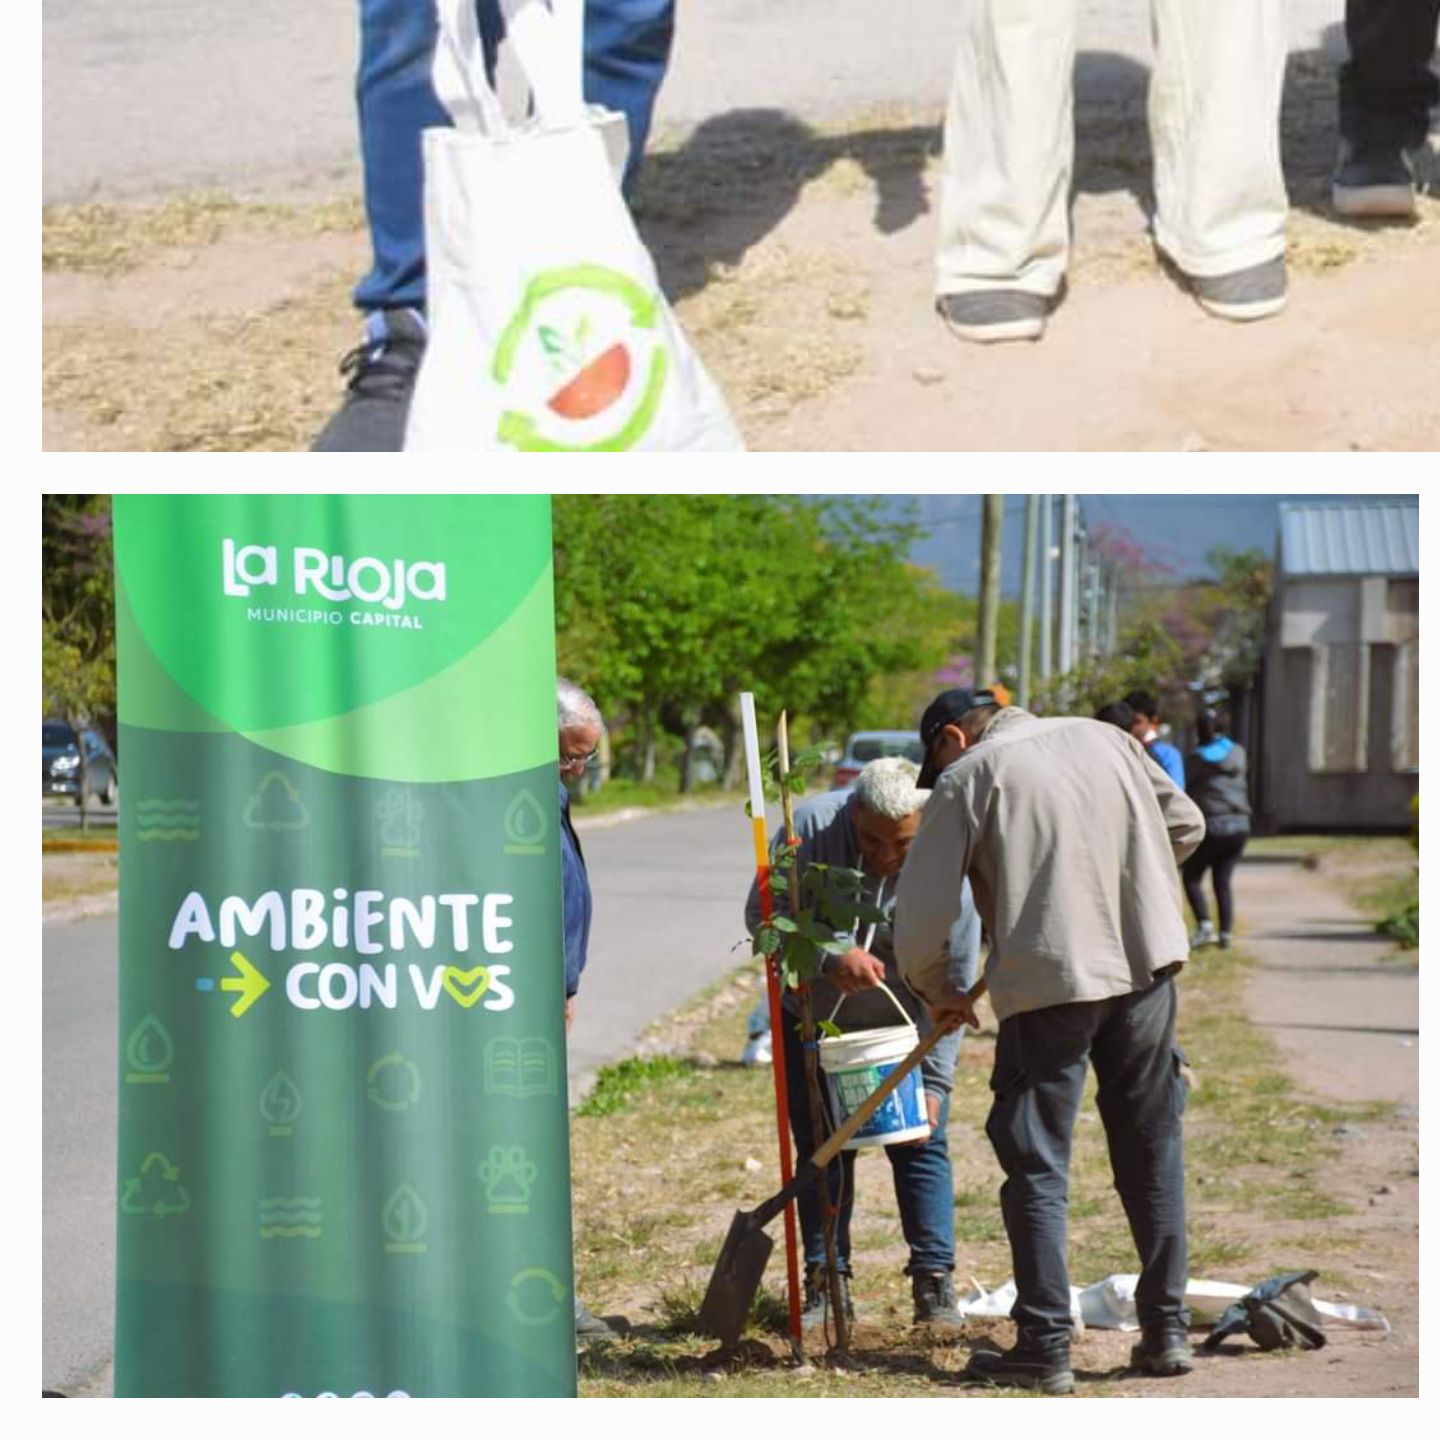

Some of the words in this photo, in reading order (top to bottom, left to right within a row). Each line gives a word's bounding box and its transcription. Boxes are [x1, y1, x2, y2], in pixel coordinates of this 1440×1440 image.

[247, 607, 343, 625] MUNICIPIO
[350, 611, 423, 629] CAPITAL
[286, 962, 397, 1010] CON
